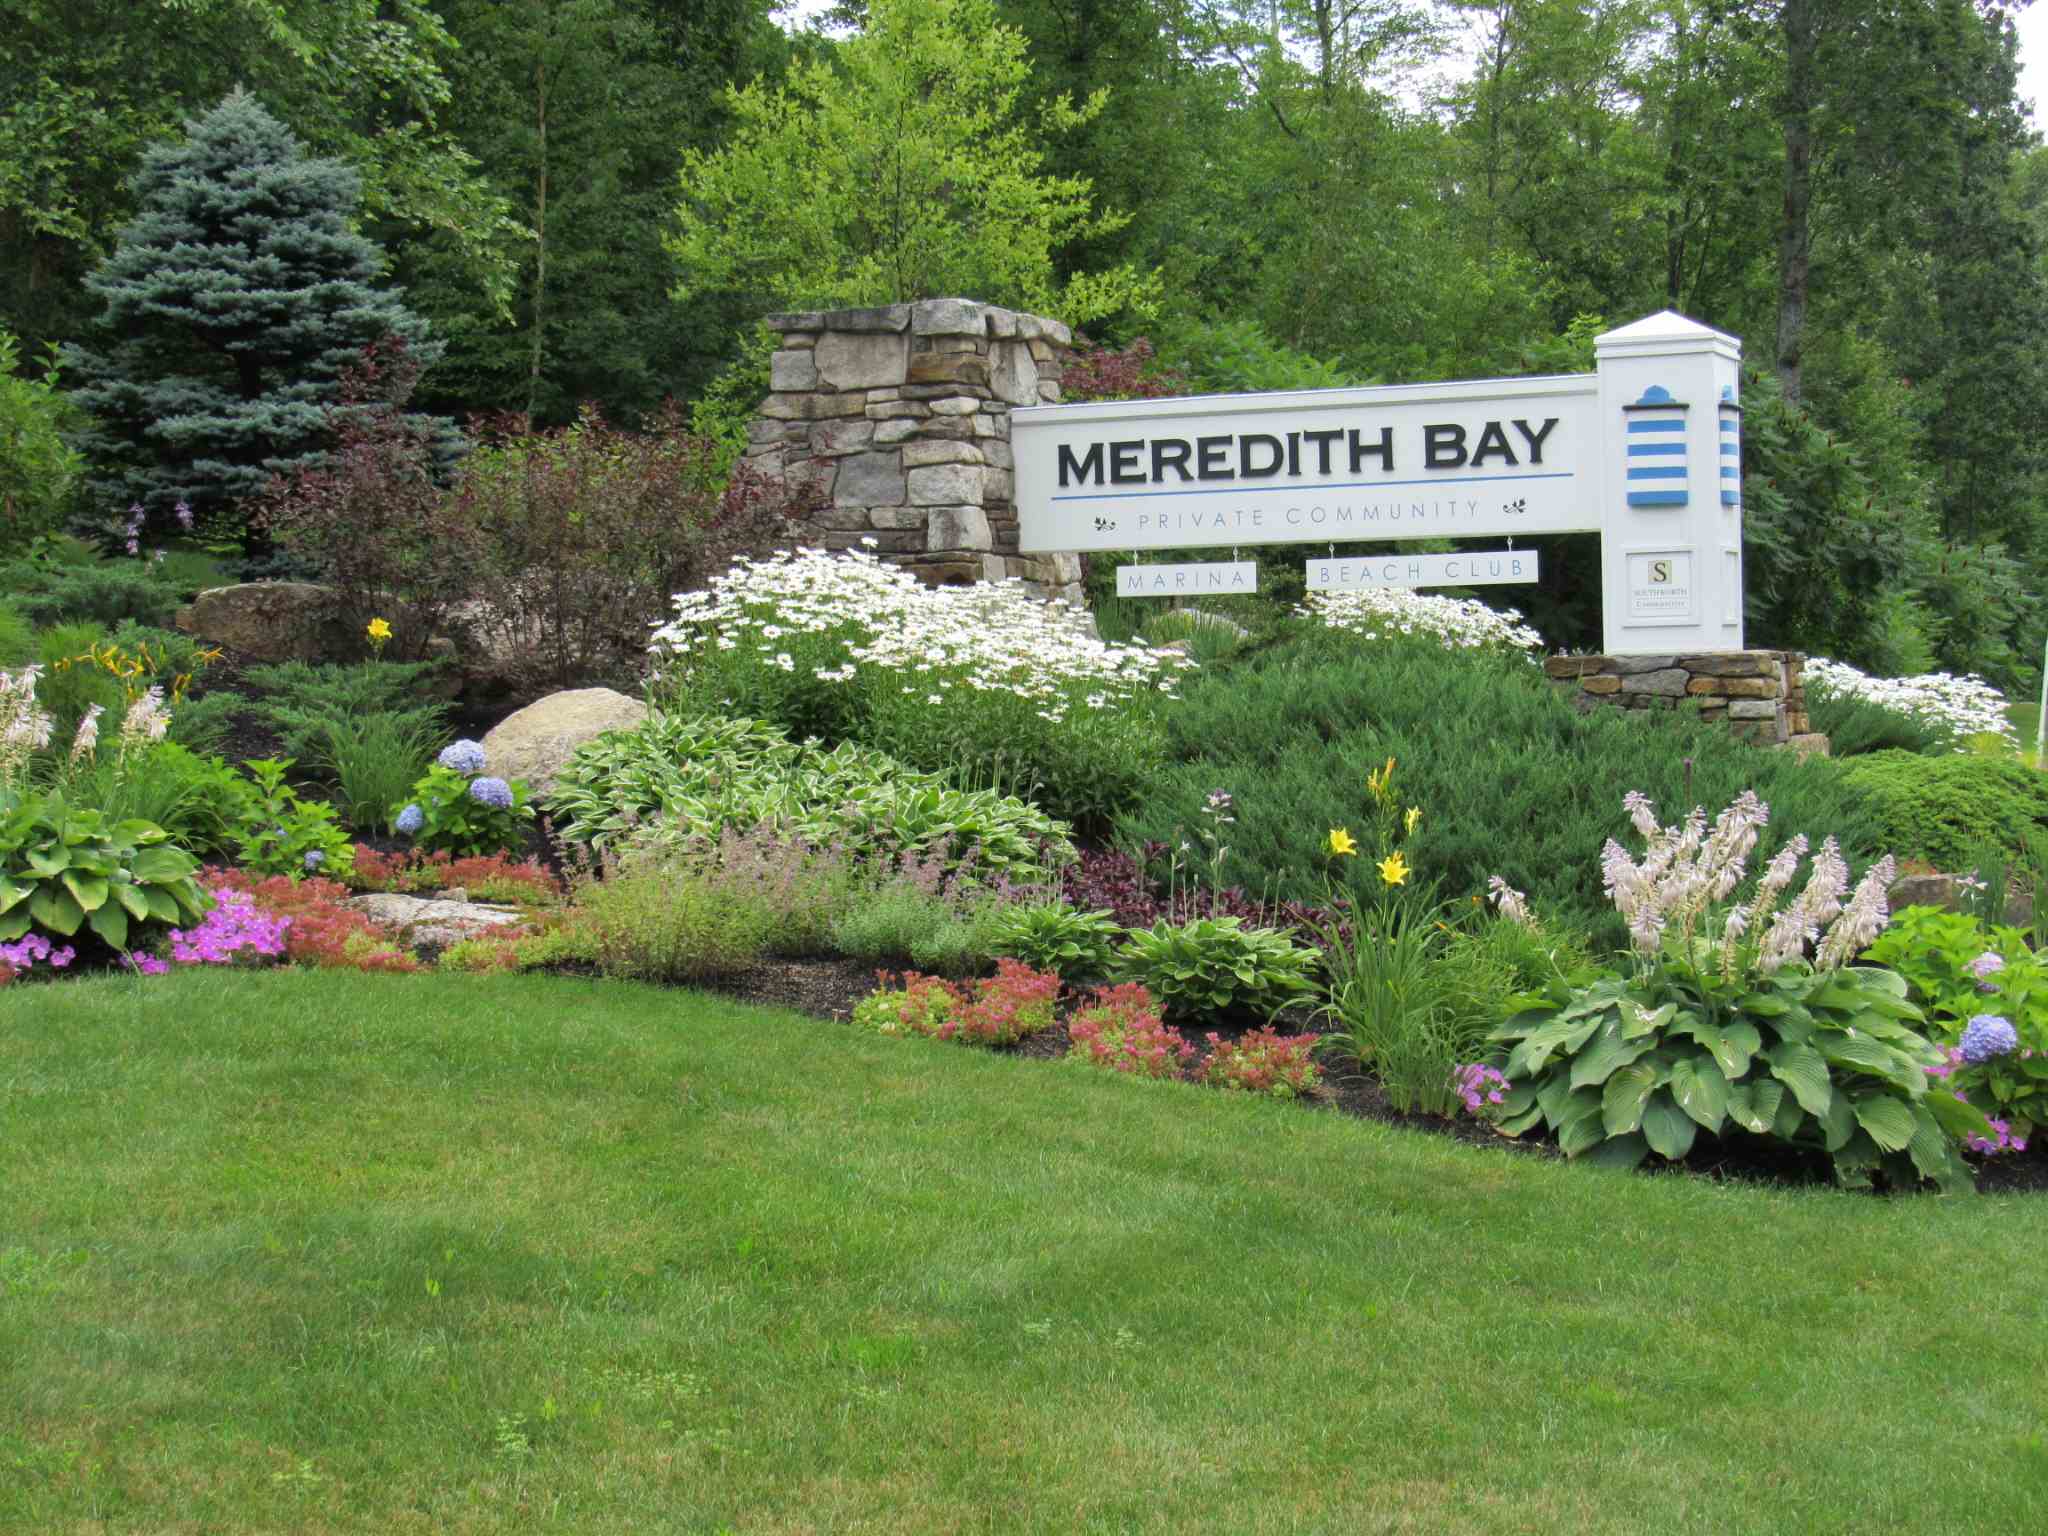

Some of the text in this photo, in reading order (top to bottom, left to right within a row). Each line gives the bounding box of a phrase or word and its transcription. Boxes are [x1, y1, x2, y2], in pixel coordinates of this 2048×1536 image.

[1057, 418, 1559, 488] MEREDITH BAY
[1139, 500, 1480, 529] PRIVATE COMMUNITY
[1127, 570, 1244, 590] MARINA
[1319, 559, 1523, 583] BEACH CLUB
[1654, 562, 1667, 582] S
